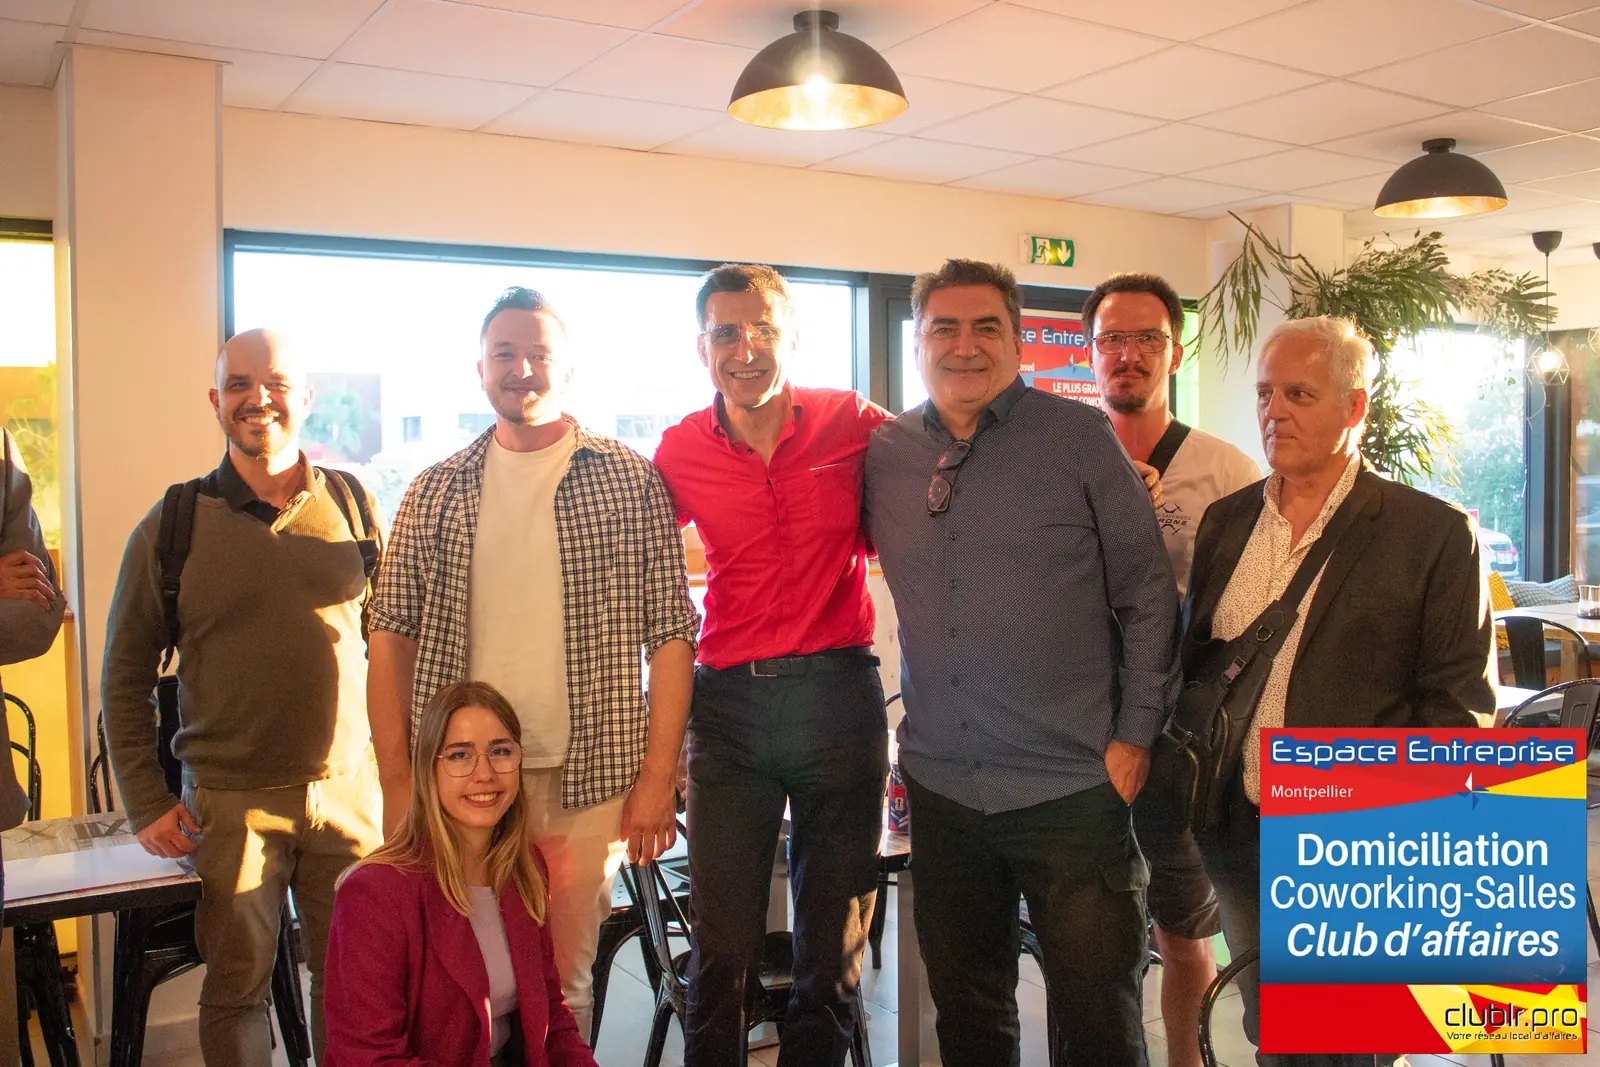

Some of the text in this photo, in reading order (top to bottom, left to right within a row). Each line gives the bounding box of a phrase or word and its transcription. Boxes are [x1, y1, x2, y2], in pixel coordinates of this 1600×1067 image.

[1042, 328, 1084, 345] Entre
[1053, 382, 1062, 393] LE
[1063, 383, 1081, 394] PLUS
